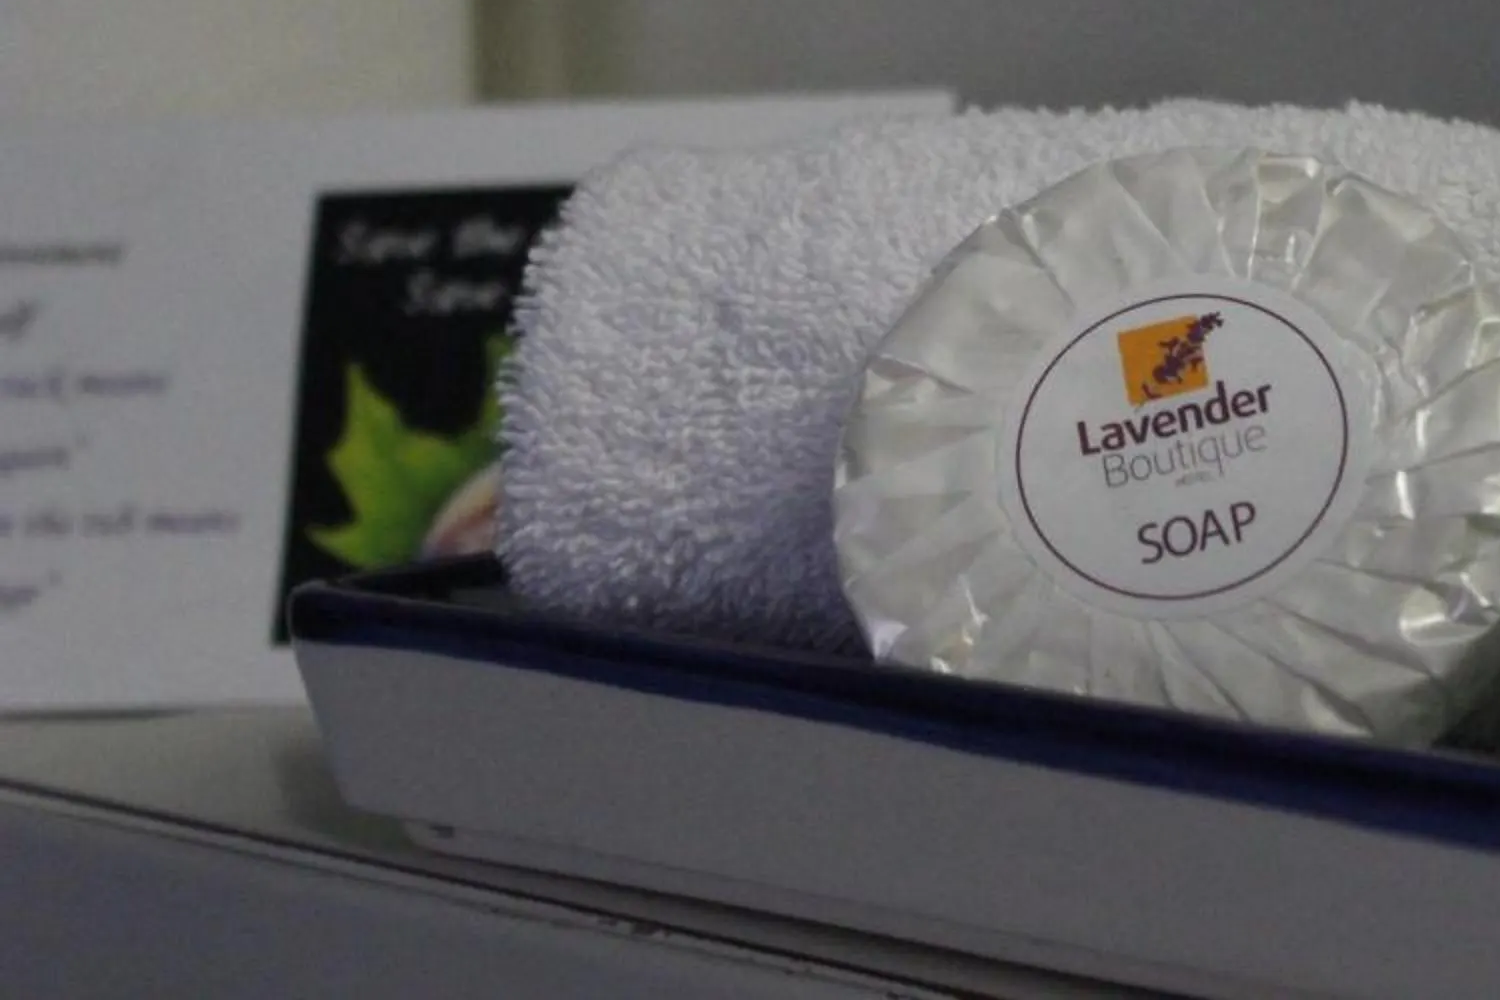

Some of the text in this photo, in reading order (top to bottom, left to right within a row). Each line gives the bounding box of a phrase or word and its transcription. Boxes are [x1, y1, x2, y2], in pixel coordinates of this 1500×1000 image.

[1077, 380, 1272, 456] Lavender
[1101, 424, 1268, 489] Boutique
[1137, 501, 1257, 565] SOAP
